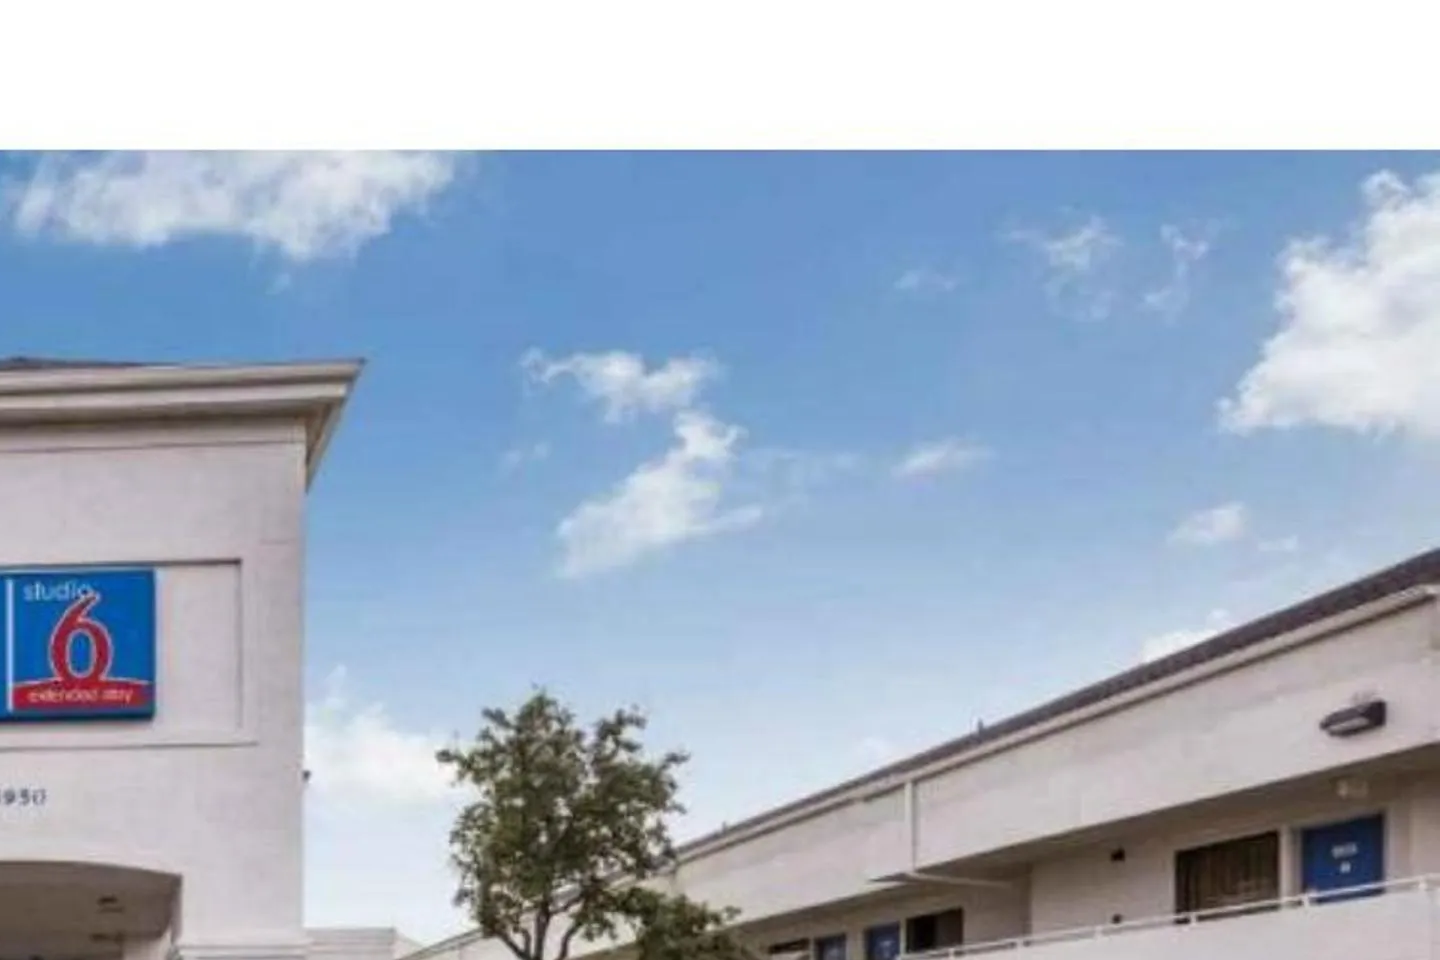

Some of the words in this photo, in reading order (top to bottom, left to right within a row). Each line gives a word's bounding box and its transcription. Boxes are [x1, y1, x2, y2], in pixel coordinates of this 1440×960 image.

[23, 582, 94, 601] studio
[48, 590, 114, 682] 6
[27, 686, 98, 703] extended
